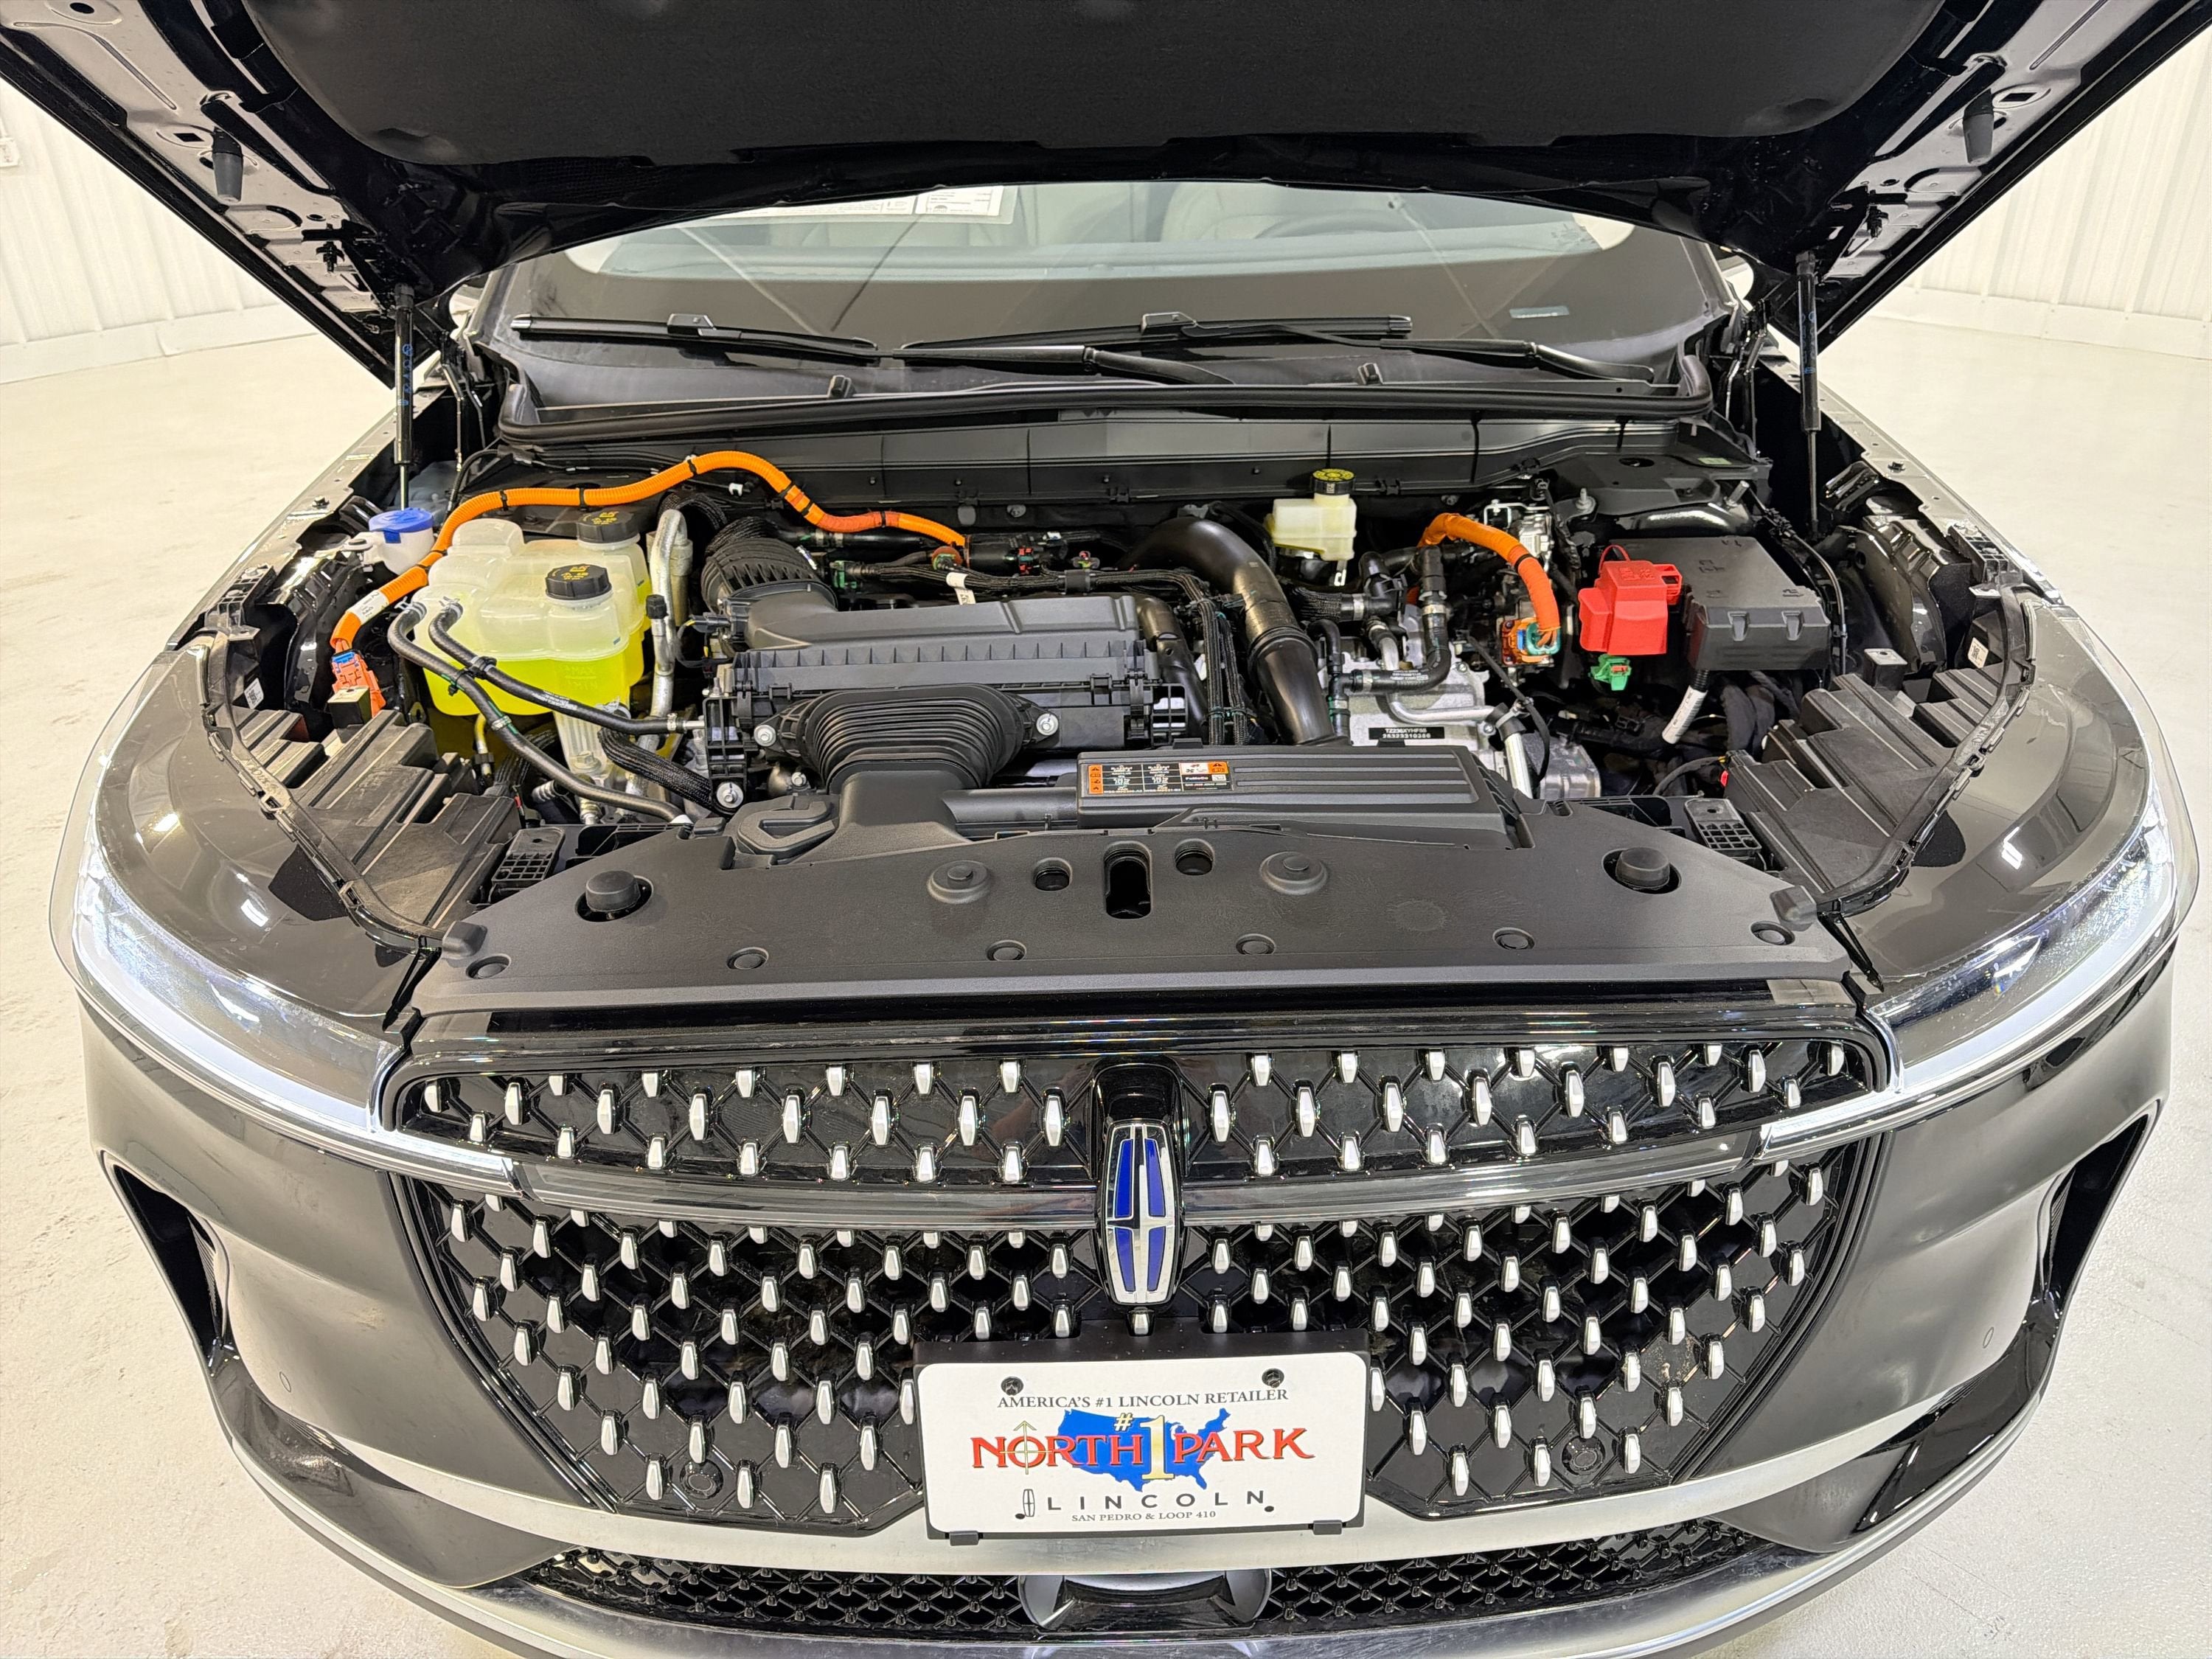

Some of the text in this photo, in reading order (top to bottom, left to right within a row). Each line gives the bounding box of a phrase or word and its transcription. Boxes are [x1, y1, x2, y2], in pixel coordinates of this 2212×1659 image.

[997, 1389, 1289, 1408] AMERICA'S #1 LINCOLN RETAILER
[970, 1434, 1144, 1469] NORTH
[1173, 1427, 1316, 1464] PARK
[1047, 1490, 1265, 1511] LINCOLN
[1071, 1510, 1217, 1522] SAN PEDRO & LOOP 410
